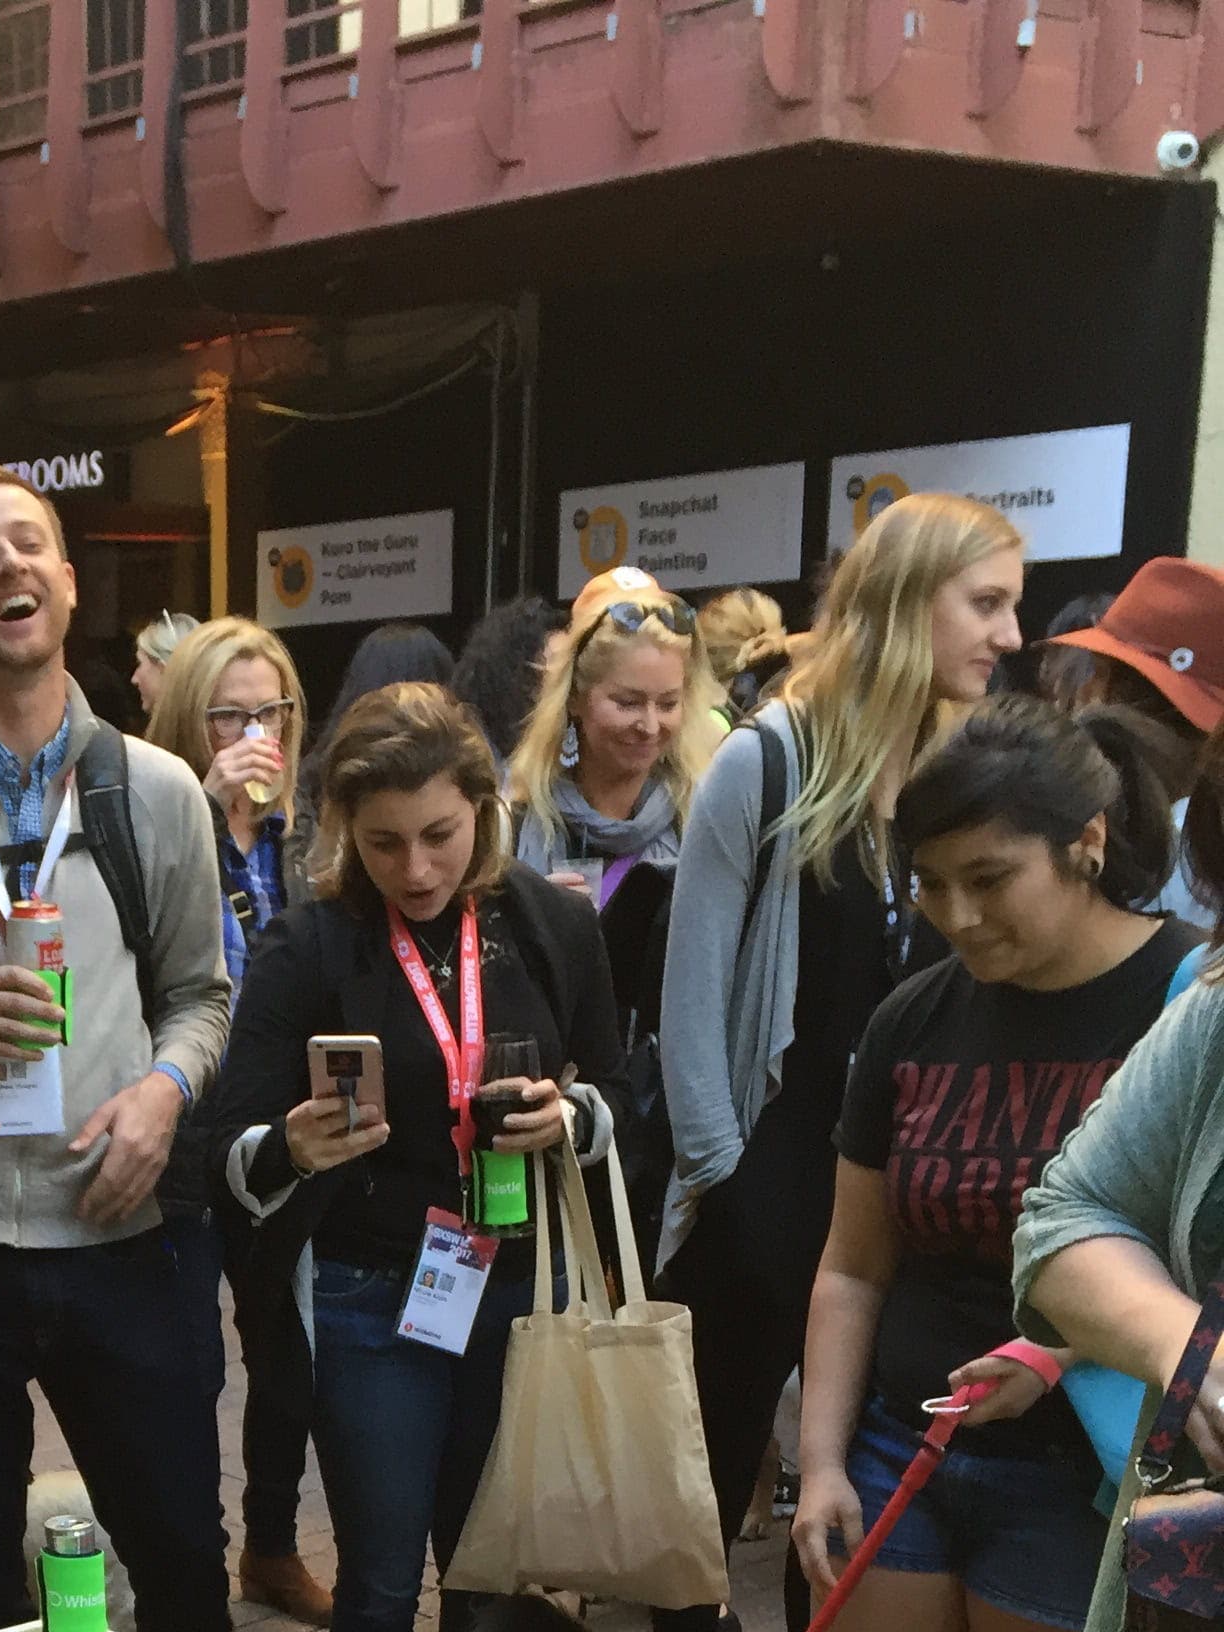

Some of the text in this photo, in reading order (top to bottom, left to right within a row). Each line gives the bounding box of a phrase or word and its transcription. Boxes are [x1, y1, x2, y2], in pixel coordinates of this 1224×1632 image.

[638, 494, 719, 519] Snapchat
[357, 537, 379, 553] the
[638, 527, 677, 546] Face
[336, 558, 417, 580] Clairvoyant
[637, 552, 708, 575] Painting
[449, 1244, 474, 1260] 2017
